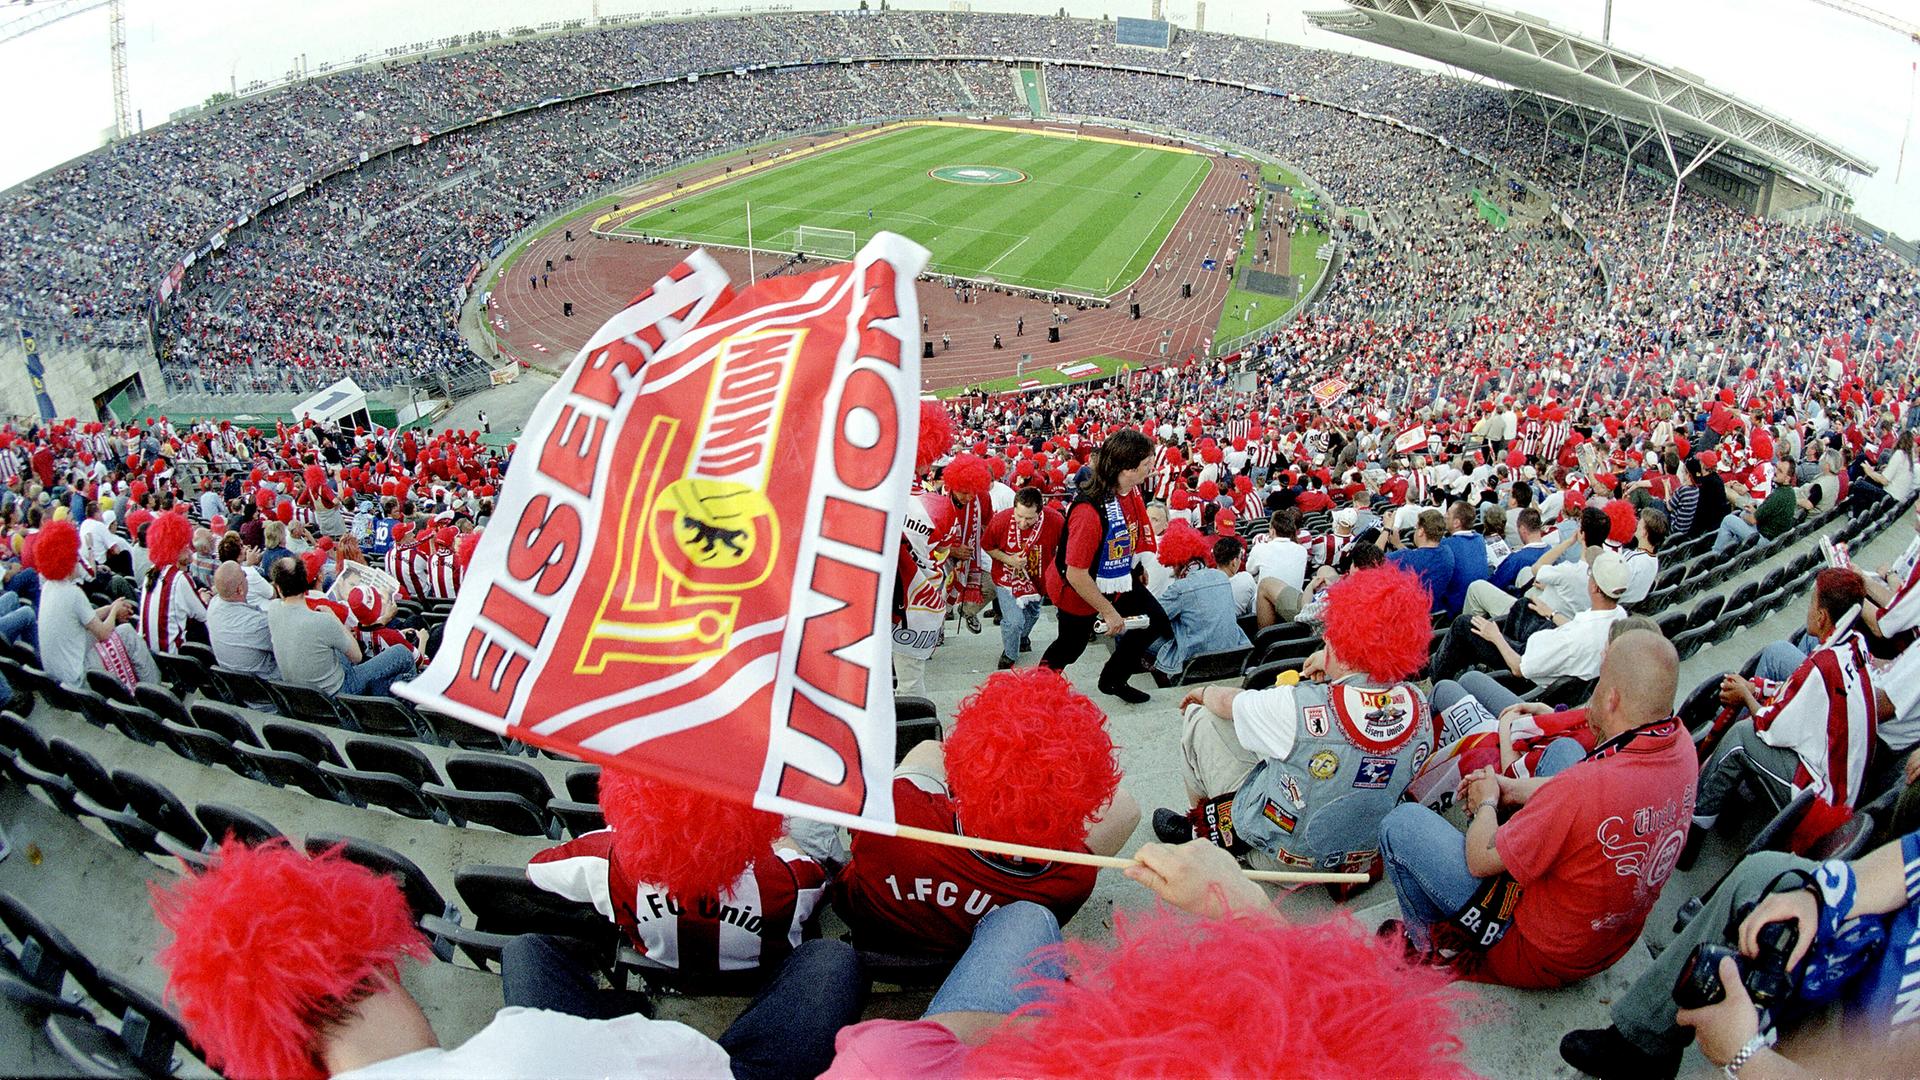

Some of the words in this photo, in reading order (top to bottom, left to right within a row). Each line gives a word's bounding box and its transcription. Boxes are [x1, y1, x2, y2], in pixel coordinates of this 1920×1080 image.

[313, 391, 352, 411] 1
[698, 338, 790, 478] UNION
[1527, 430, 1539, 441] 26
[375, 526, 389, 541] 10
[776, 258, 902, 817] UNION
[1364, 725, 1384, 738] Eisern
[1386, 722, 1405, 737] Union
[885, 874, 959, 907] 1.FC
